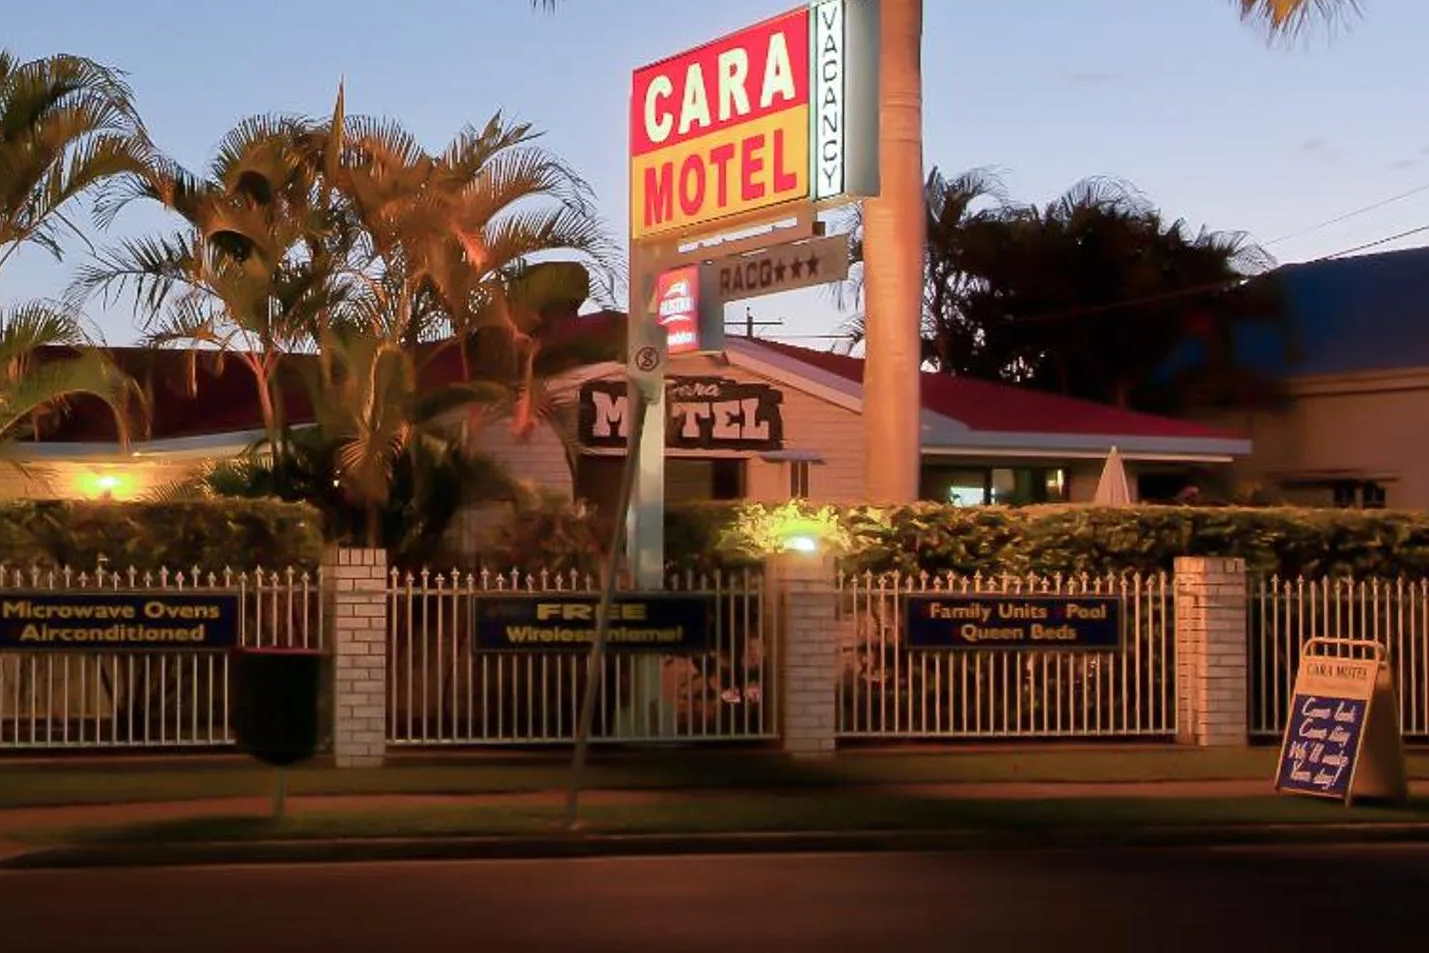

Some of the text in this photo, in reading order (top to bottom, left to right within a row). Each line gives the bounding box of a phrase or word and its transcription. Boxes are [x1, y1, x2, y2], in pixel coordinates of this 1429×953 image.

[644, 31, 796, 143] CARA
[821, 5, 838, 189] VACANCY
[644, 128, 797, 228] MOTEL
[592, 391, 769, 440] MTEL
[2, 601, 220, 619] Microwave Ovens
[930, 602, 1107, 622] Family Units Pool
[20, 624, 205, 642] Airconditioned
[960, 624, 1077, 642] Queen Beds
